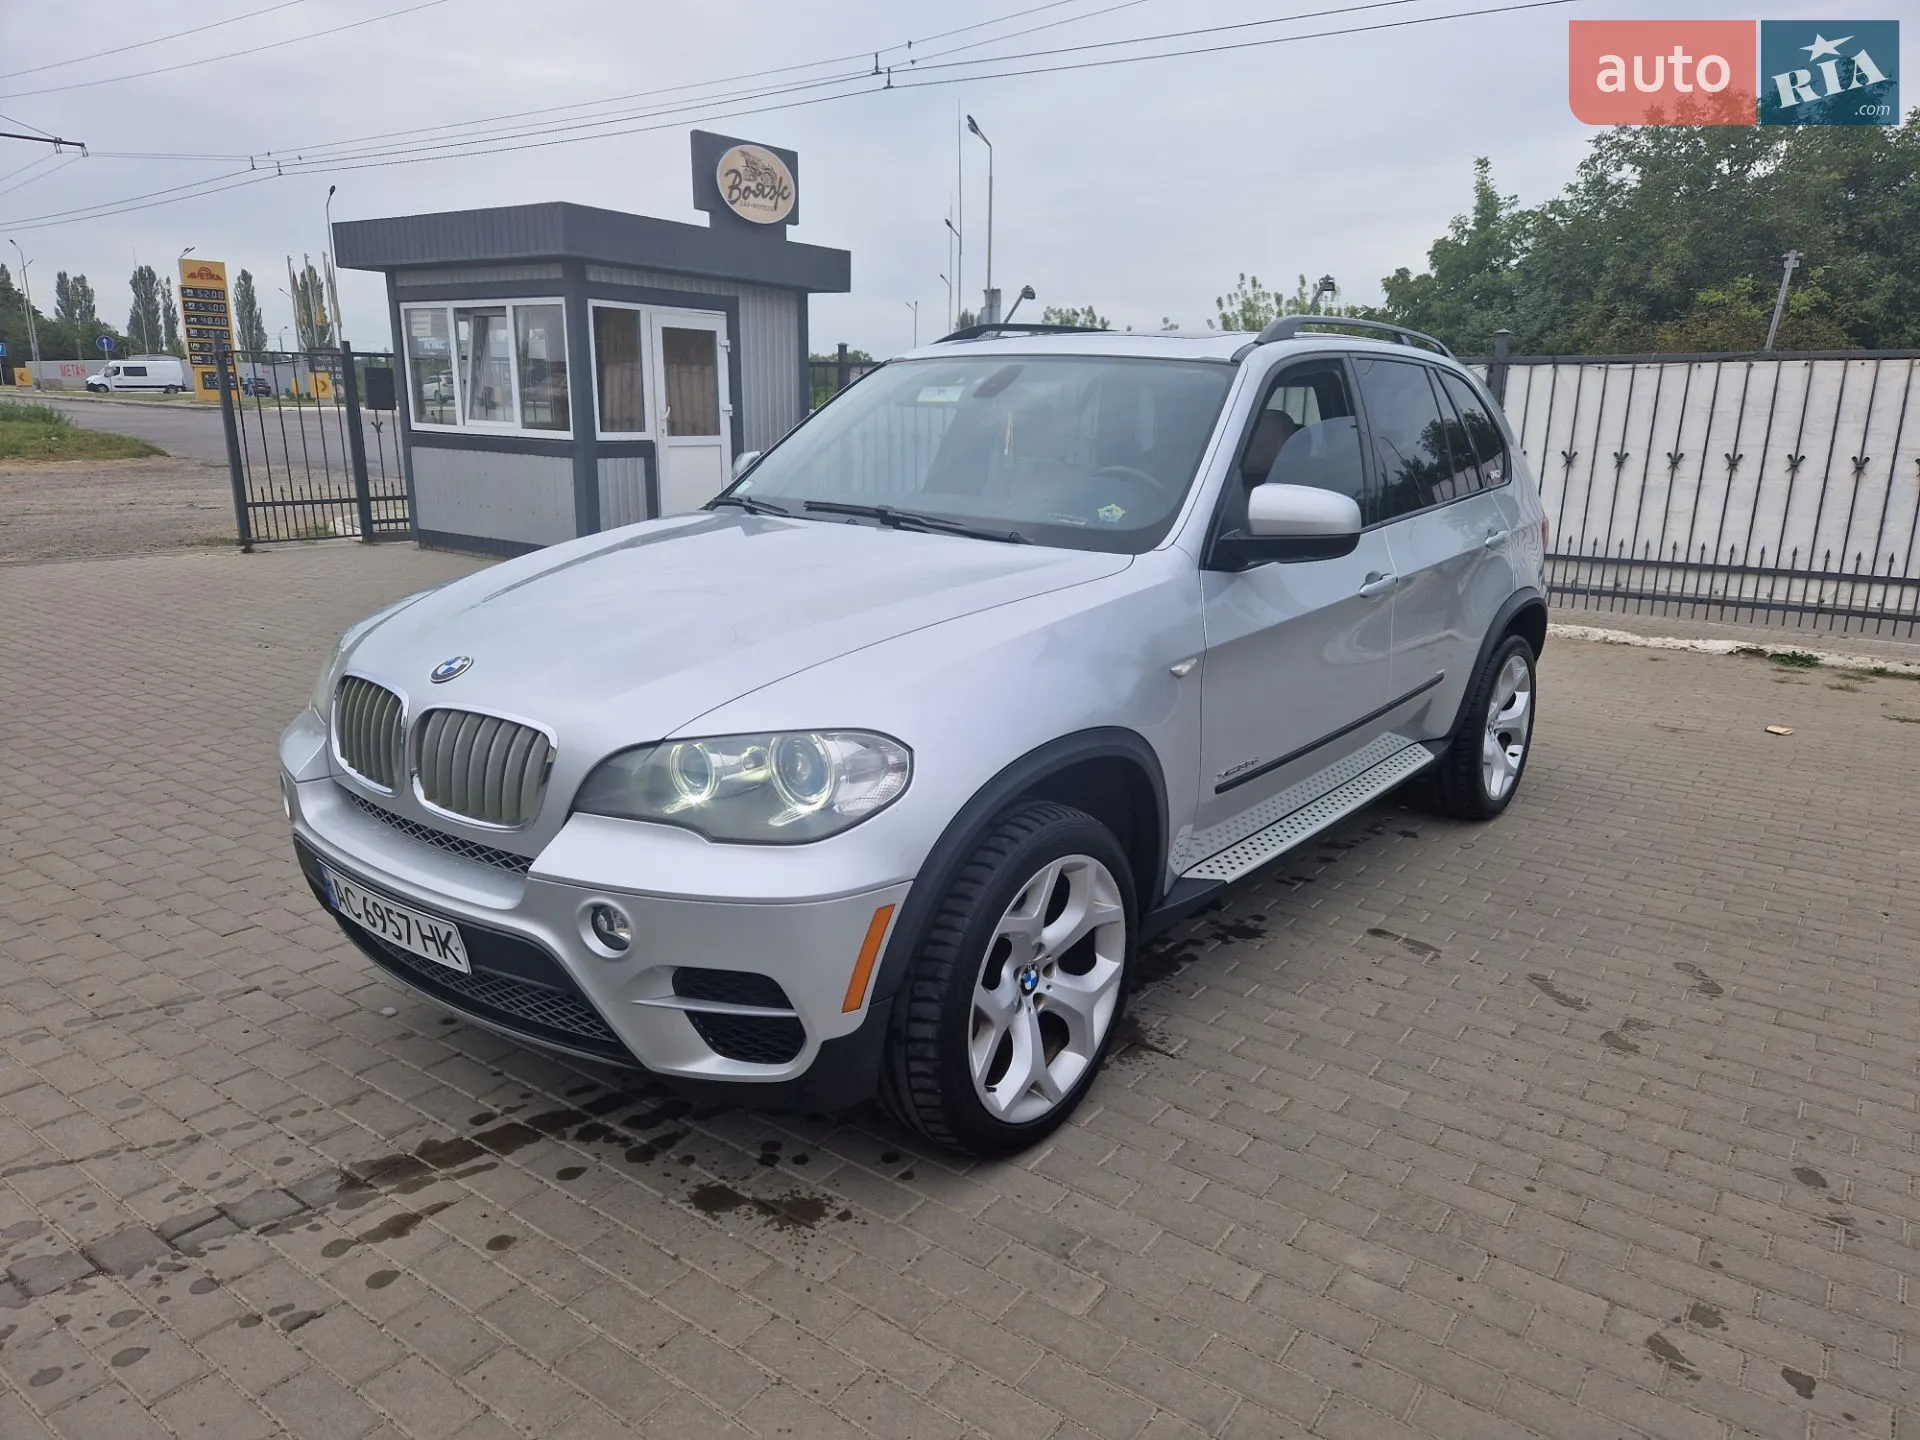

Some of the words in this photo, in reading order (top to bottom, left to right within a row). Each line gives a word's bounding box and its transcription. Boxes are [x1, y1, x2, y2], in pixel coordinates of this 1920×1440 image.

[333, 878, 362, 919] AC
[362, 896, 412, 945] 6957
[414, 919, 462, 965] HK
